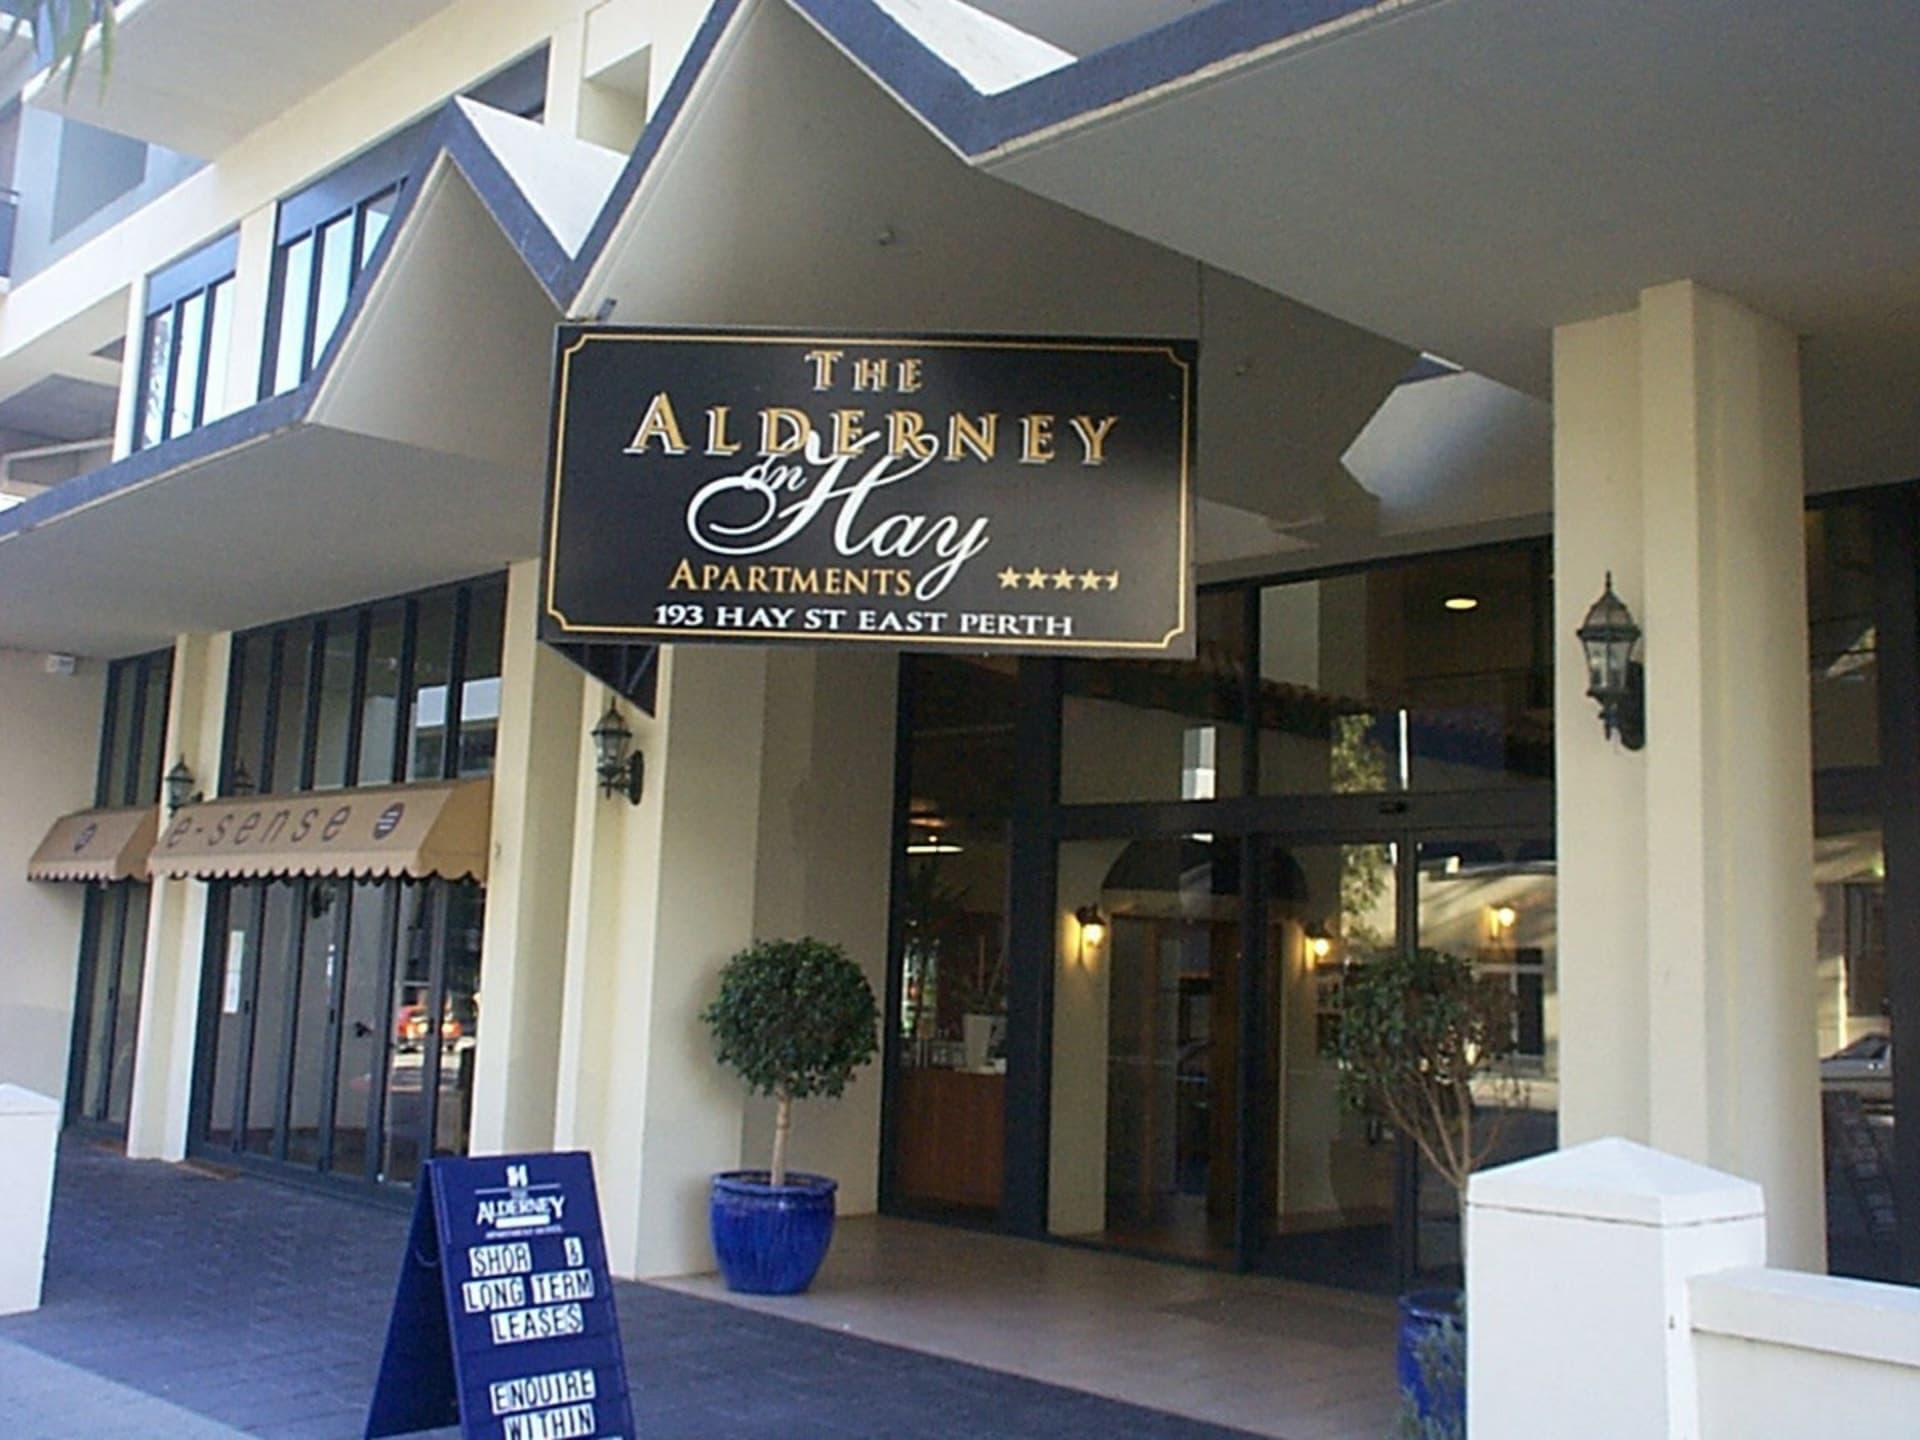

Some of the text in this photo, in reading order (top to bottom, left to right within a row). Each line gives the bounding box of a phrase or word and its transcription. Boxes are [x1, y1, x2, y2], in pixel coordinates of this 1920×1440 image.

[804, 349, 924, 394] THE
[622, 390, 1121, 466] ALDERNEY
[686, 429, 990, 601] Hay
[669, 557, 912, 597] APARTMENTS
[654, 604, 1073, 638] 193 HAY ST EAST PERTH
[166, 804, 352, 849] e-sense
[476, 1195, 565, 1226] ALDERNEY
[466, 1272, 593, 1309] LONG TERM
[494, 1304, 581, 1341] LEASES
[494, 1371, 593, 1411] ENQUIRE
[508, 1406, 593, 1440] WITHIN
